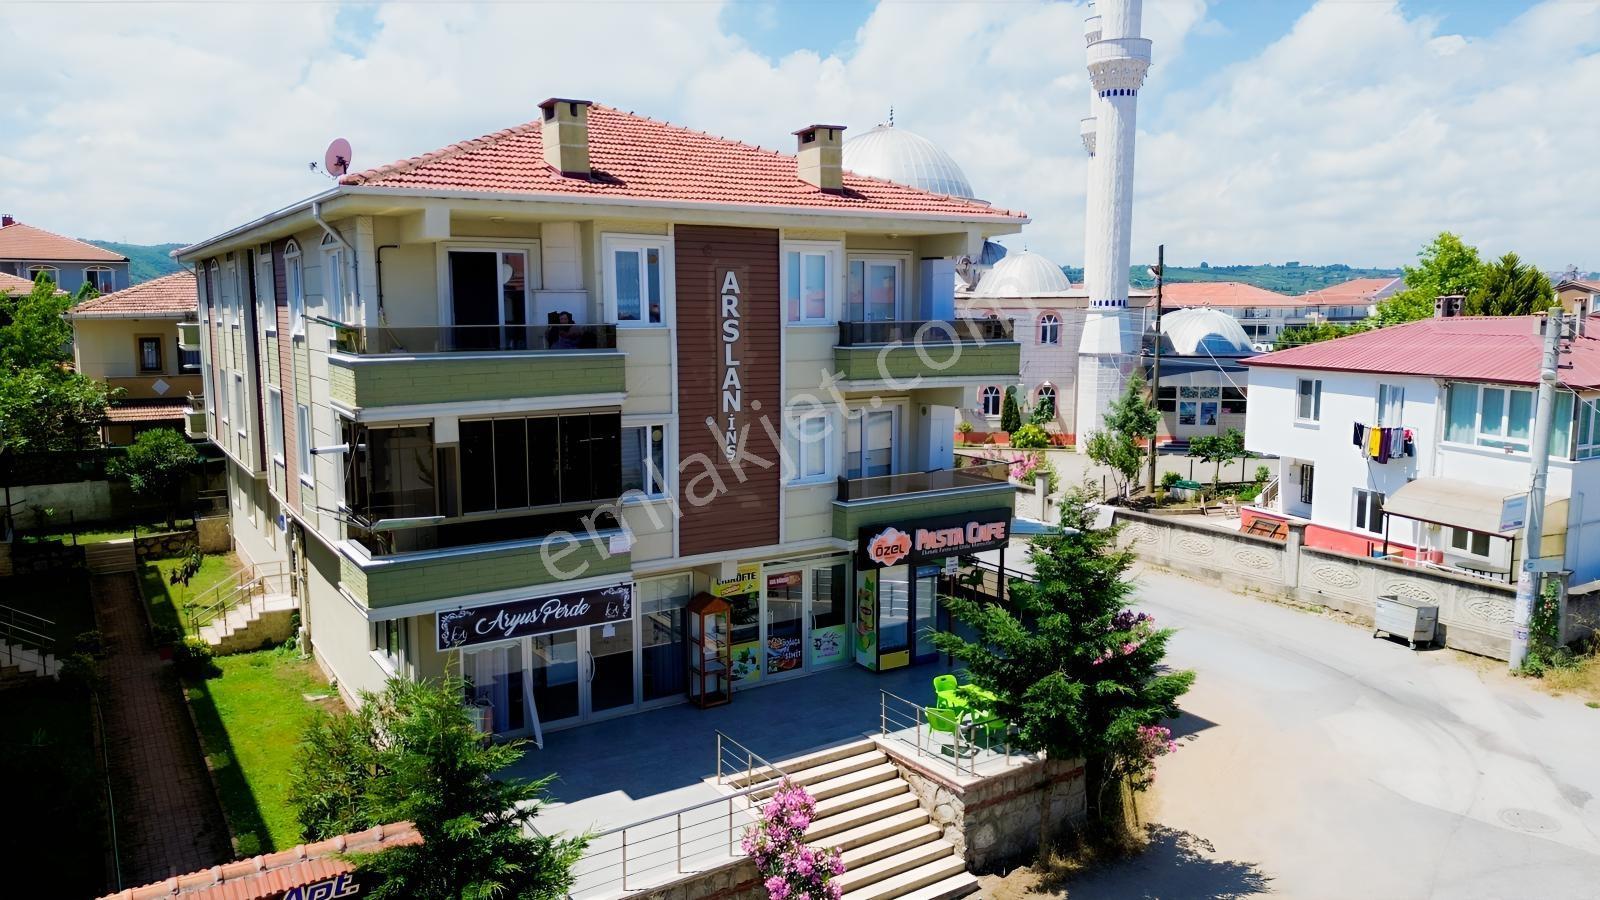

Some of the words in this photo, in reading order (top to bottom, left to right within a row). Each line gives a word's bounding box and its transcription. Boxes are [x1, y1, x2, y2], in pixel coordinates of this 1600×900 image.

[720, 271, 742, 413] ARSLAN
[475, 609, 541, 636] Aryus
[539, 598, 591, 623] Perde
